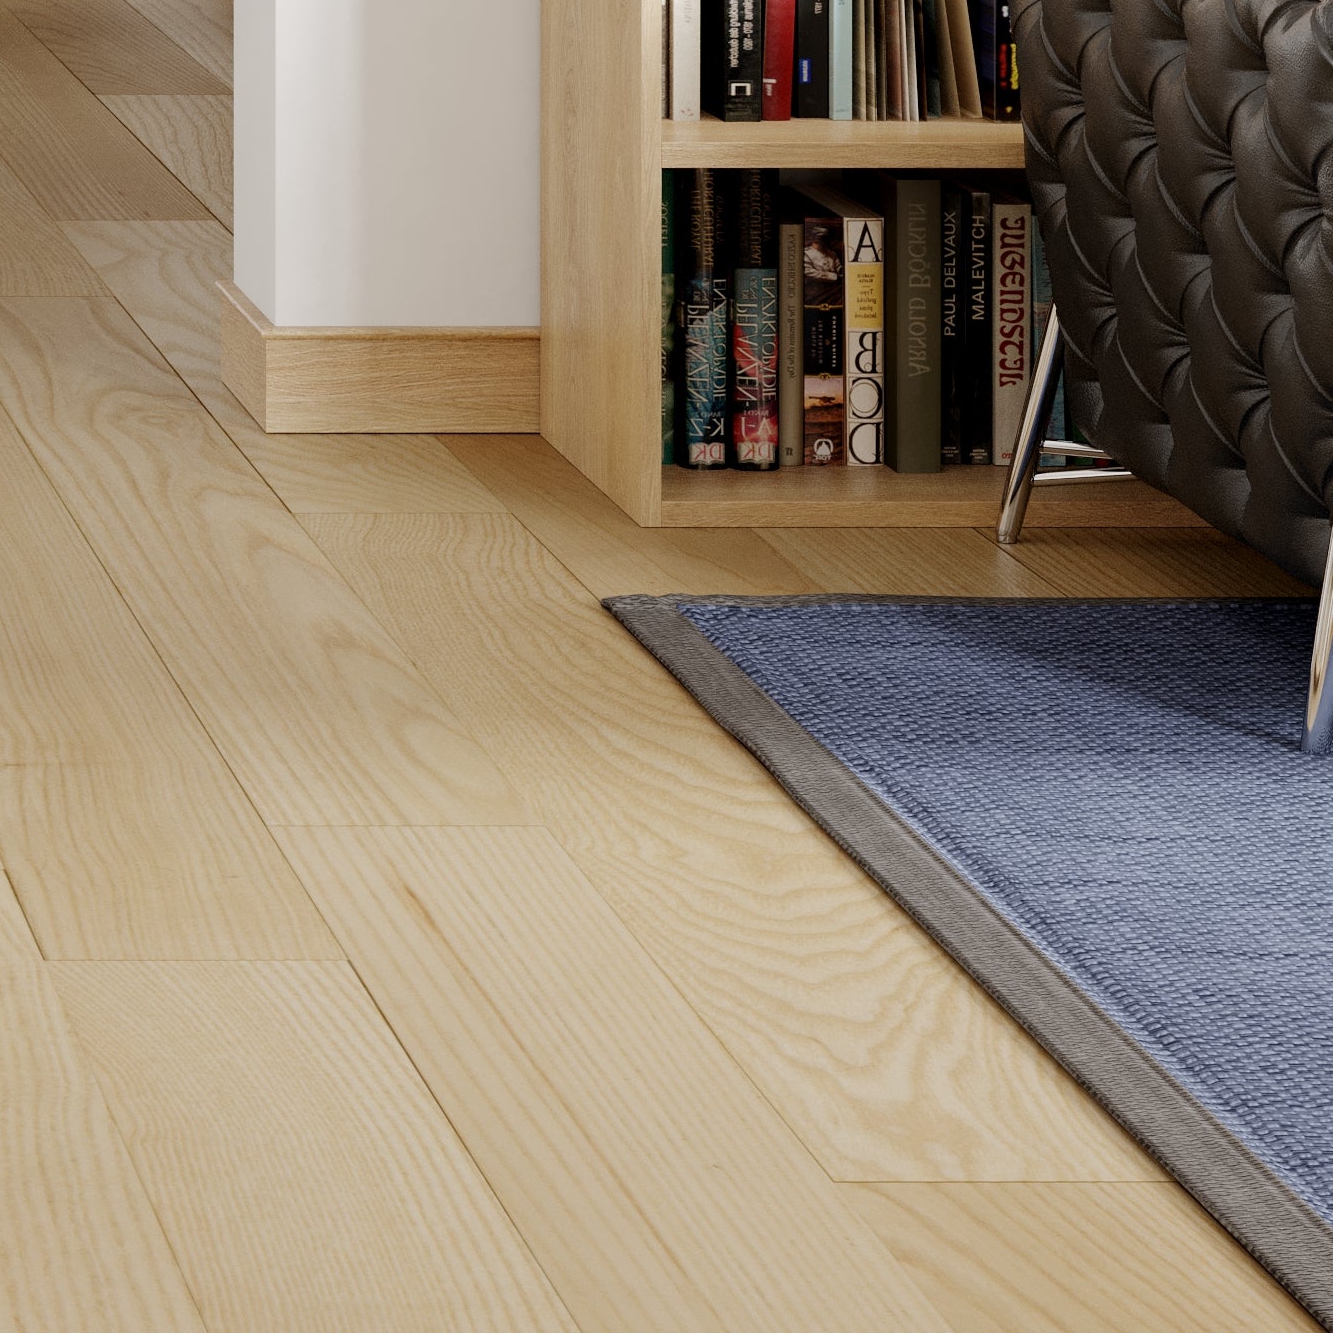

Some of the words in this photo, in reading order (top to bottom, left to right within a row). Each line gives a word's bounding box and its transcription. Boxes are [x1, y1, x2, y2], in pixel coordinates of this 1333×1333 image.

[943, 212, 956, 288] DELVAUX
[971, 215, 985, 320] MALEVITCH
[943, 295, 956, 336] PAUL
[998, 216, 1025, 387] JUGENDSTIL
